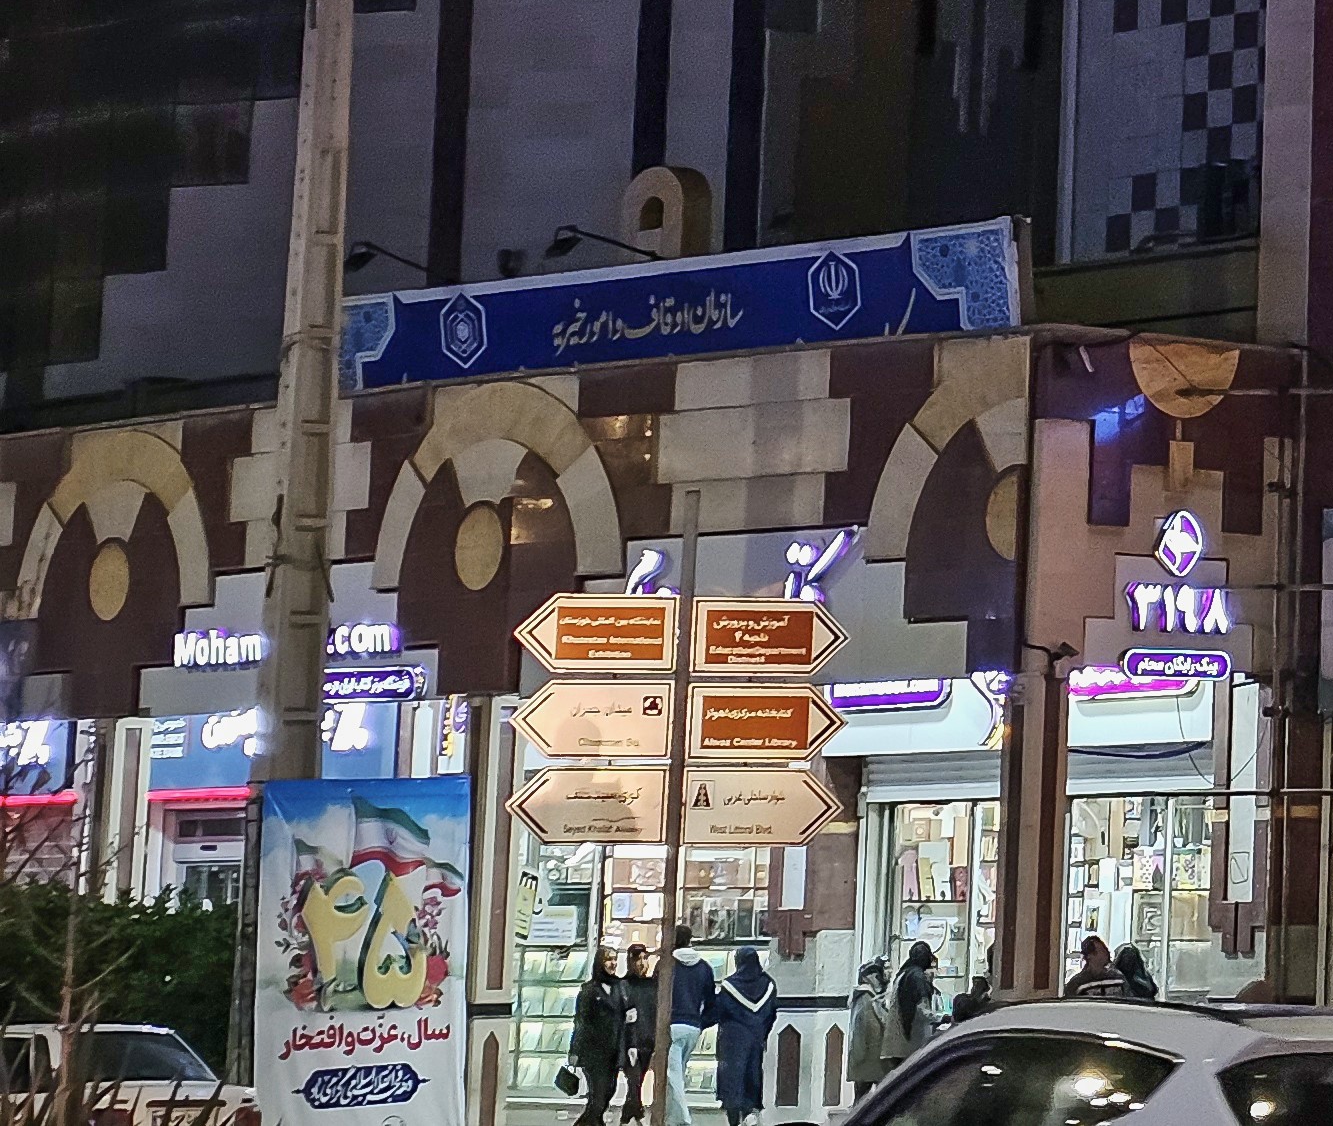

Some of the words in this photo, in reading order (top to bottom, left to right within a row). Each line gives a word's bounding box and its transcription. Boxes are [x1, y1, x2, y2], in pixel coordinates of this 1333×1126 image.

[579, 310, 613, 345] امور
[622, 294, 689, 340] اوقاف
[689, 288, 744, 335] سازمان
[277, 1015, 345, 1061] افتخار
[342, 1030, 357, 1057] و
